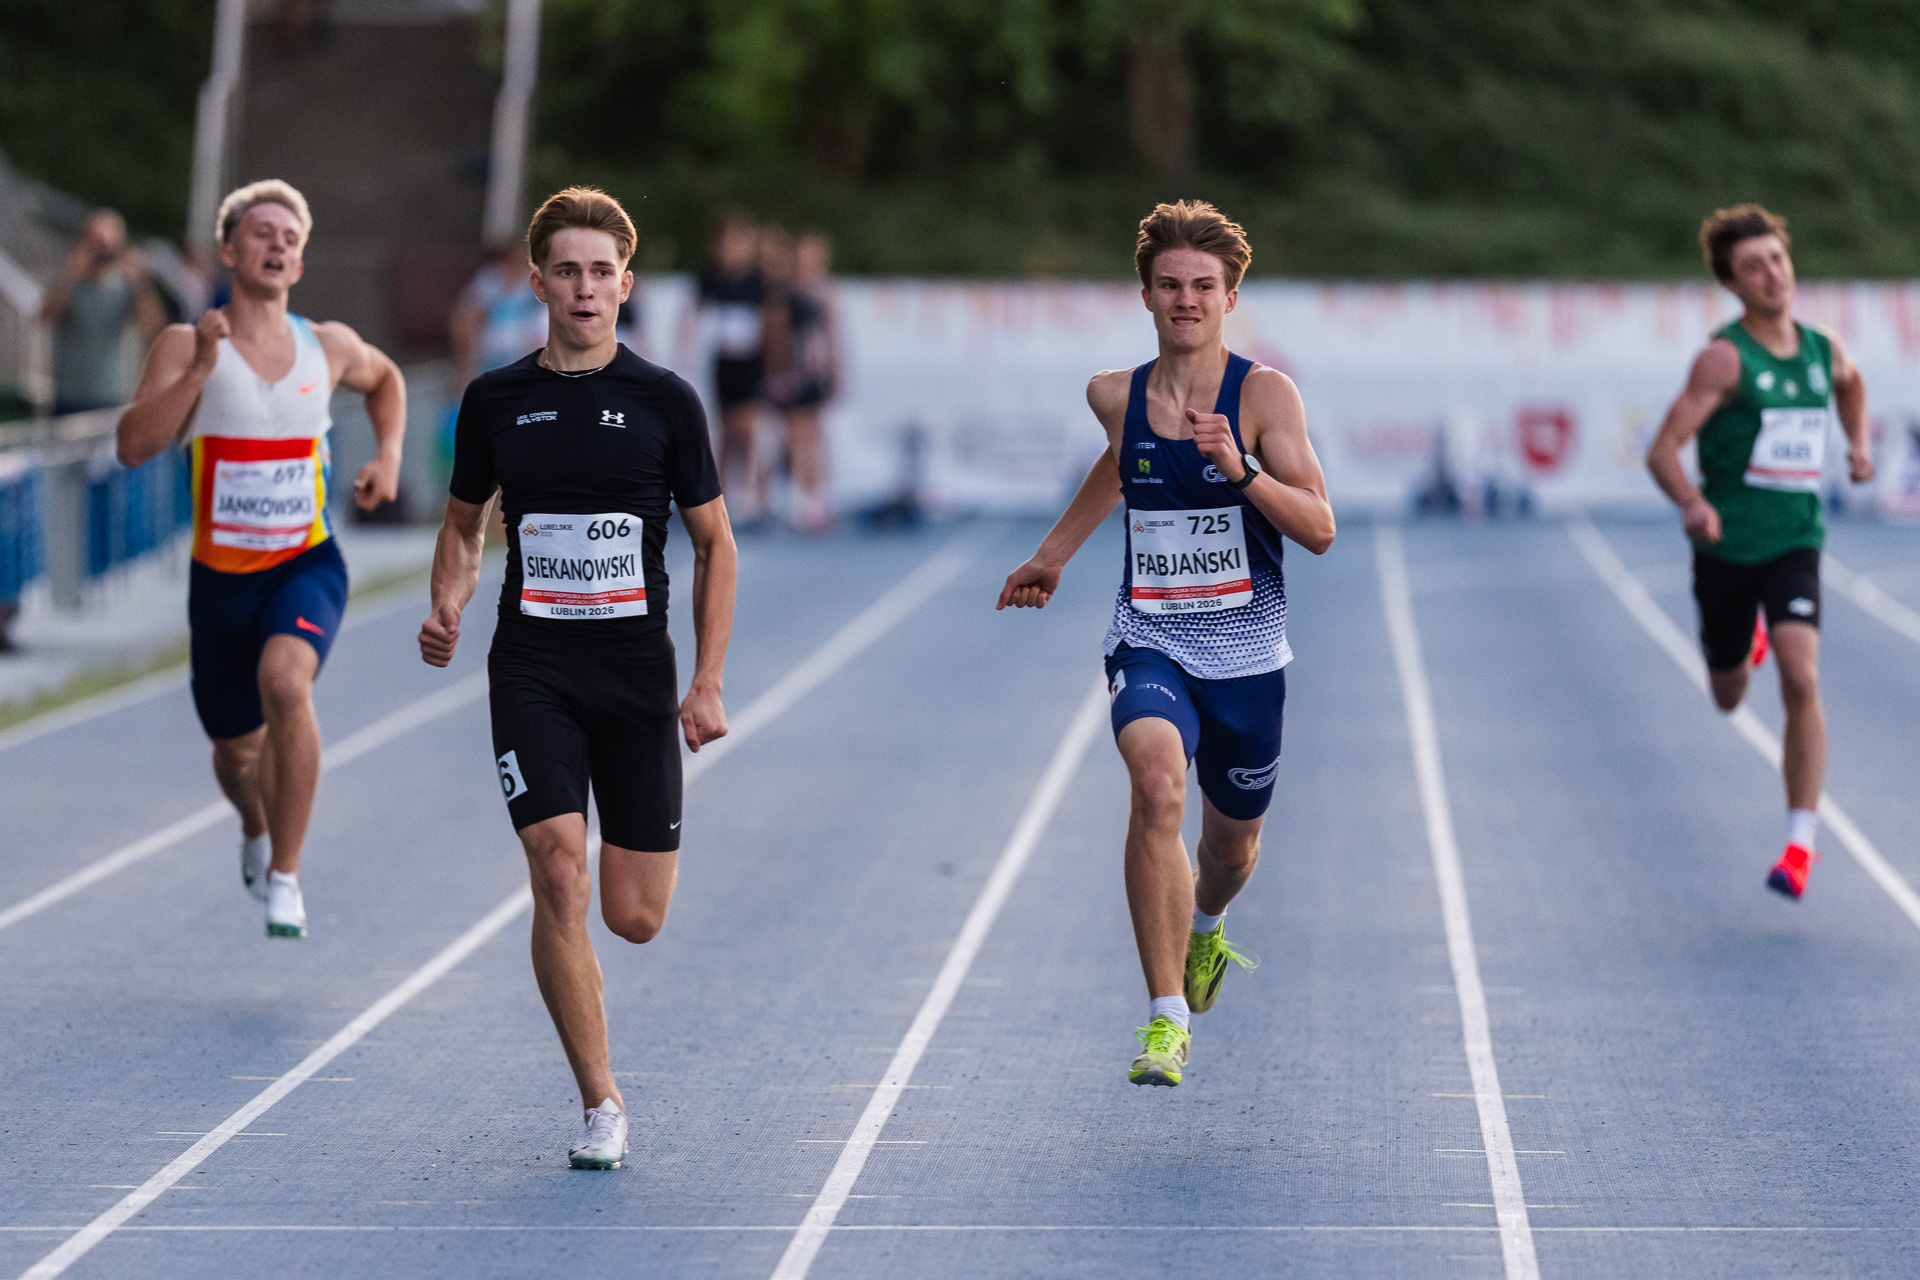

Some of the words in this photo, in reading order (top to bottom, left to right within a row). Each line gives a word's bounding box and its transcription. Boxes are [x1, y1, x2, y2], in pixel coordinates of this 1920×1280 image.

[273, 464, 306, 484] 697
[586, 518, 631, 541] 606
[1187, 513, 1230, 535] 725
[527, 554, 635, 581] SIEKANOWSKI
[1136, 547, 1241, 576] FABJAŃSKI
[550, 606, 586, 616] LUBLIN
[588, 606, 614, 616] 2026
[1161, 602, 1195, 611] LUBLIN
[1197, 599, 1222, 610] 2026
[499, 760, 516, 798] 6
